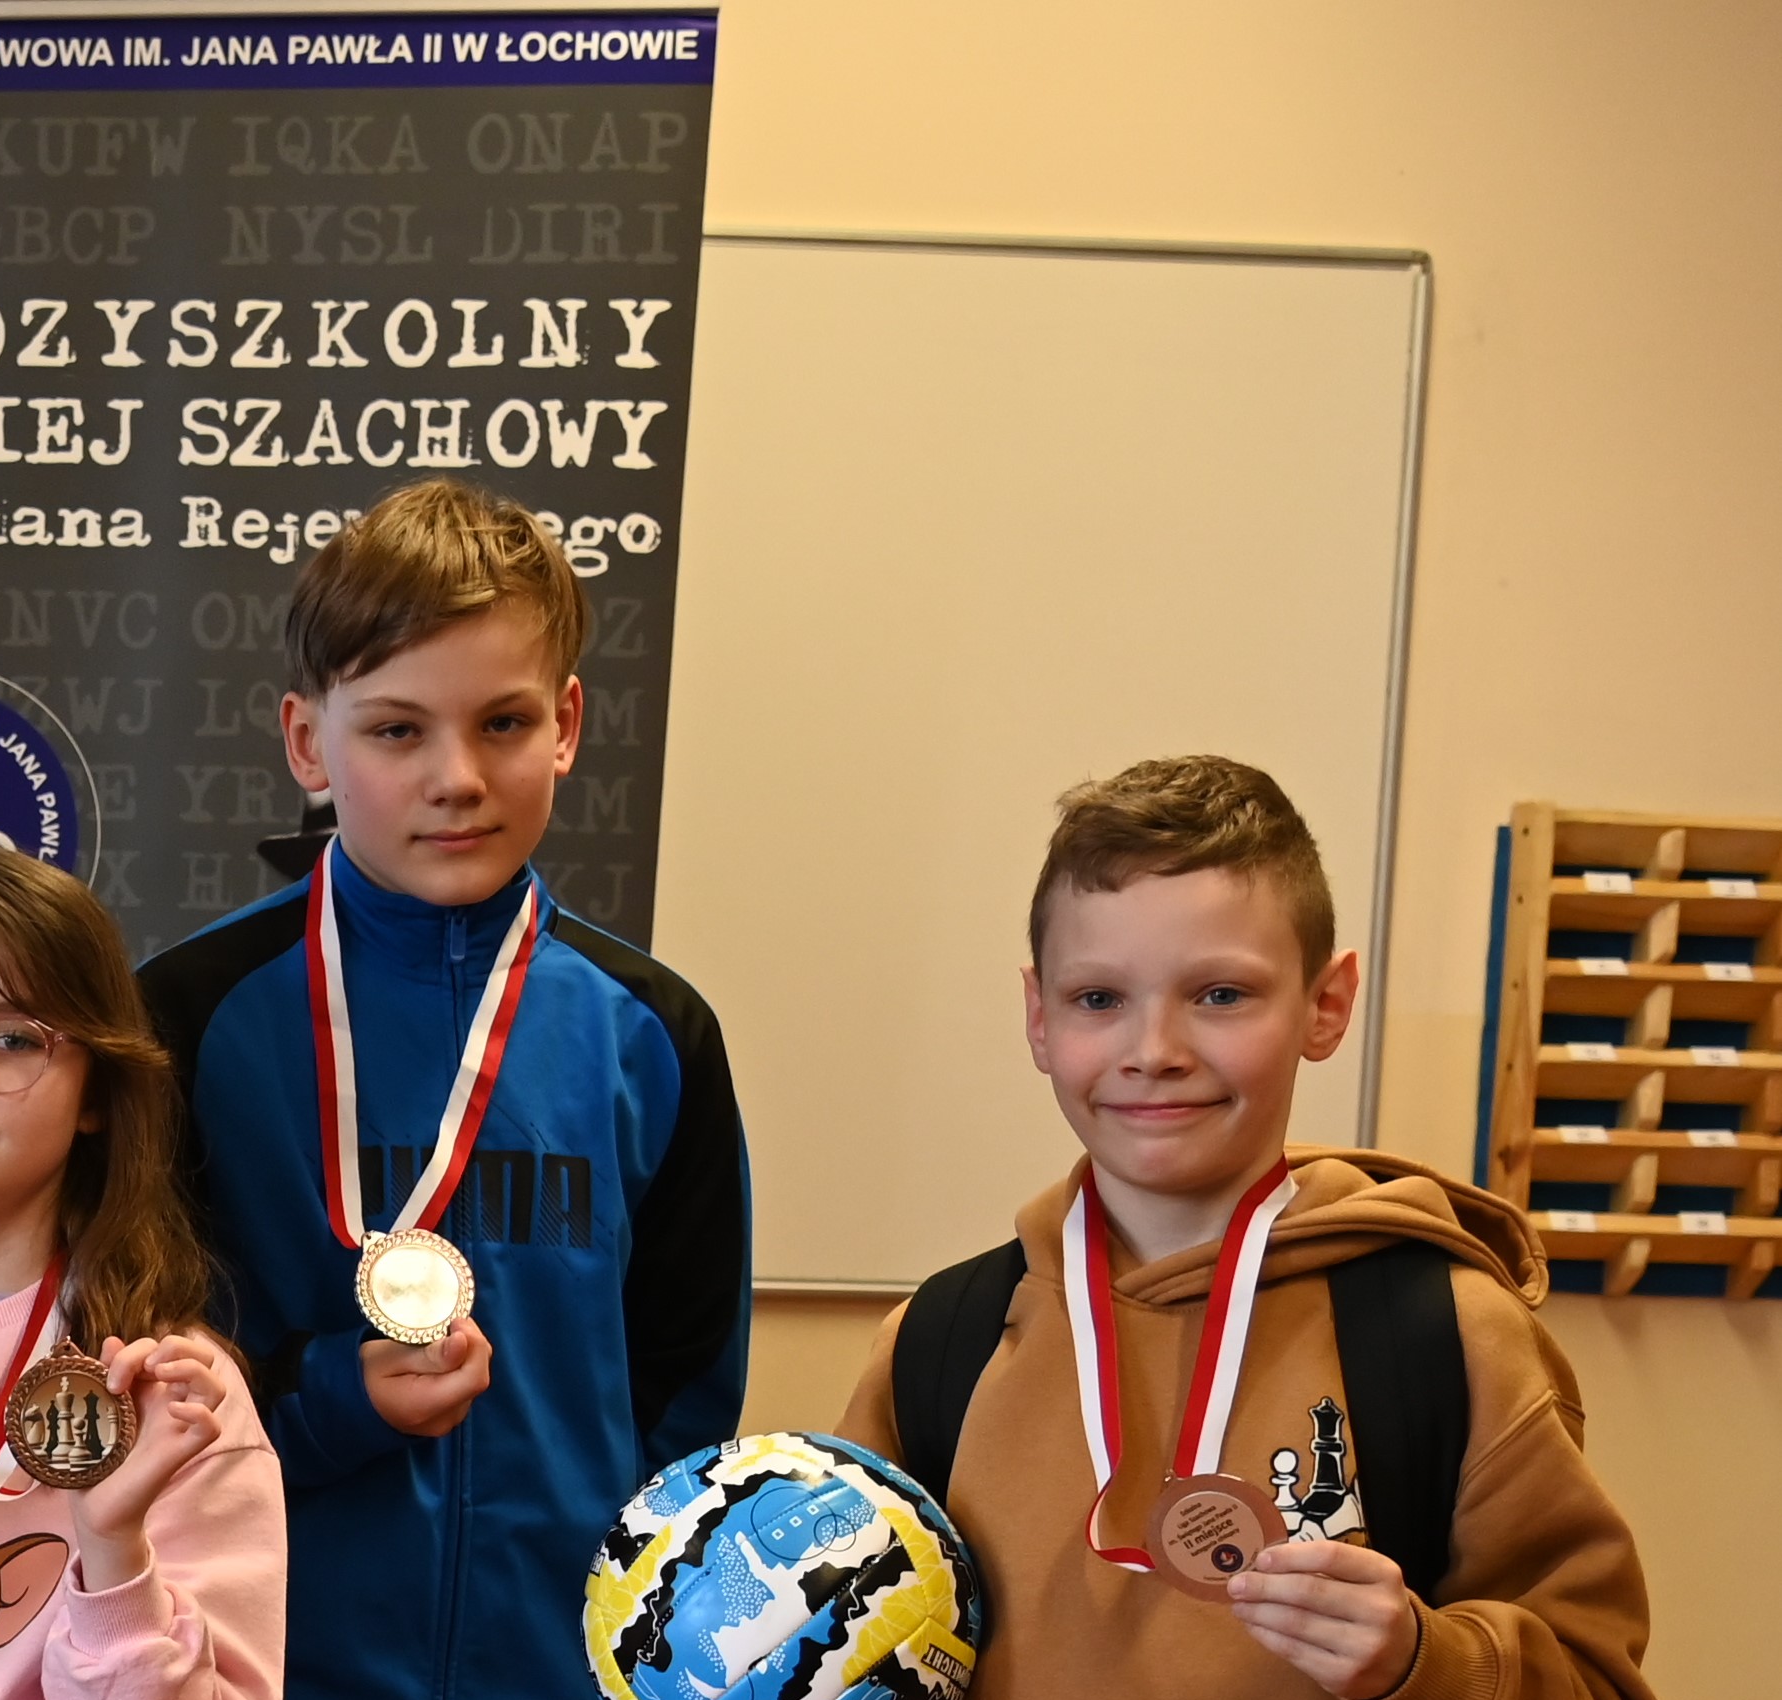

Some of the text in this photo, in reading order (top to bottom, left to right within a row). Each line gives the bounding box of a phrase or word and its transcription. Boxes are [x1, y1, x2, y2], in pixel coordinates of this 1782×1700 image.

[124, 38, 170, 66] IM.
[181, 36, 278, 66] JANA
[288, 34, 414, 64] PAWŁA
[423, 33, 441, 62] II
[453, 33, 487, 62] W
[496, 30, 698, 61] ŁOCHOWIE
[230, 114, 428, 175] IQKA
[467, 110, 688, 174] ONAP
[221, 204, 434, 265] NYSL
[470, 203, 680, 265] DIRI
[178, 399, 669, 469] SZACHOWY
[38, 791, 60, 861] PAWŁ
[1195, 1518, 1234, 1544] miejsce
